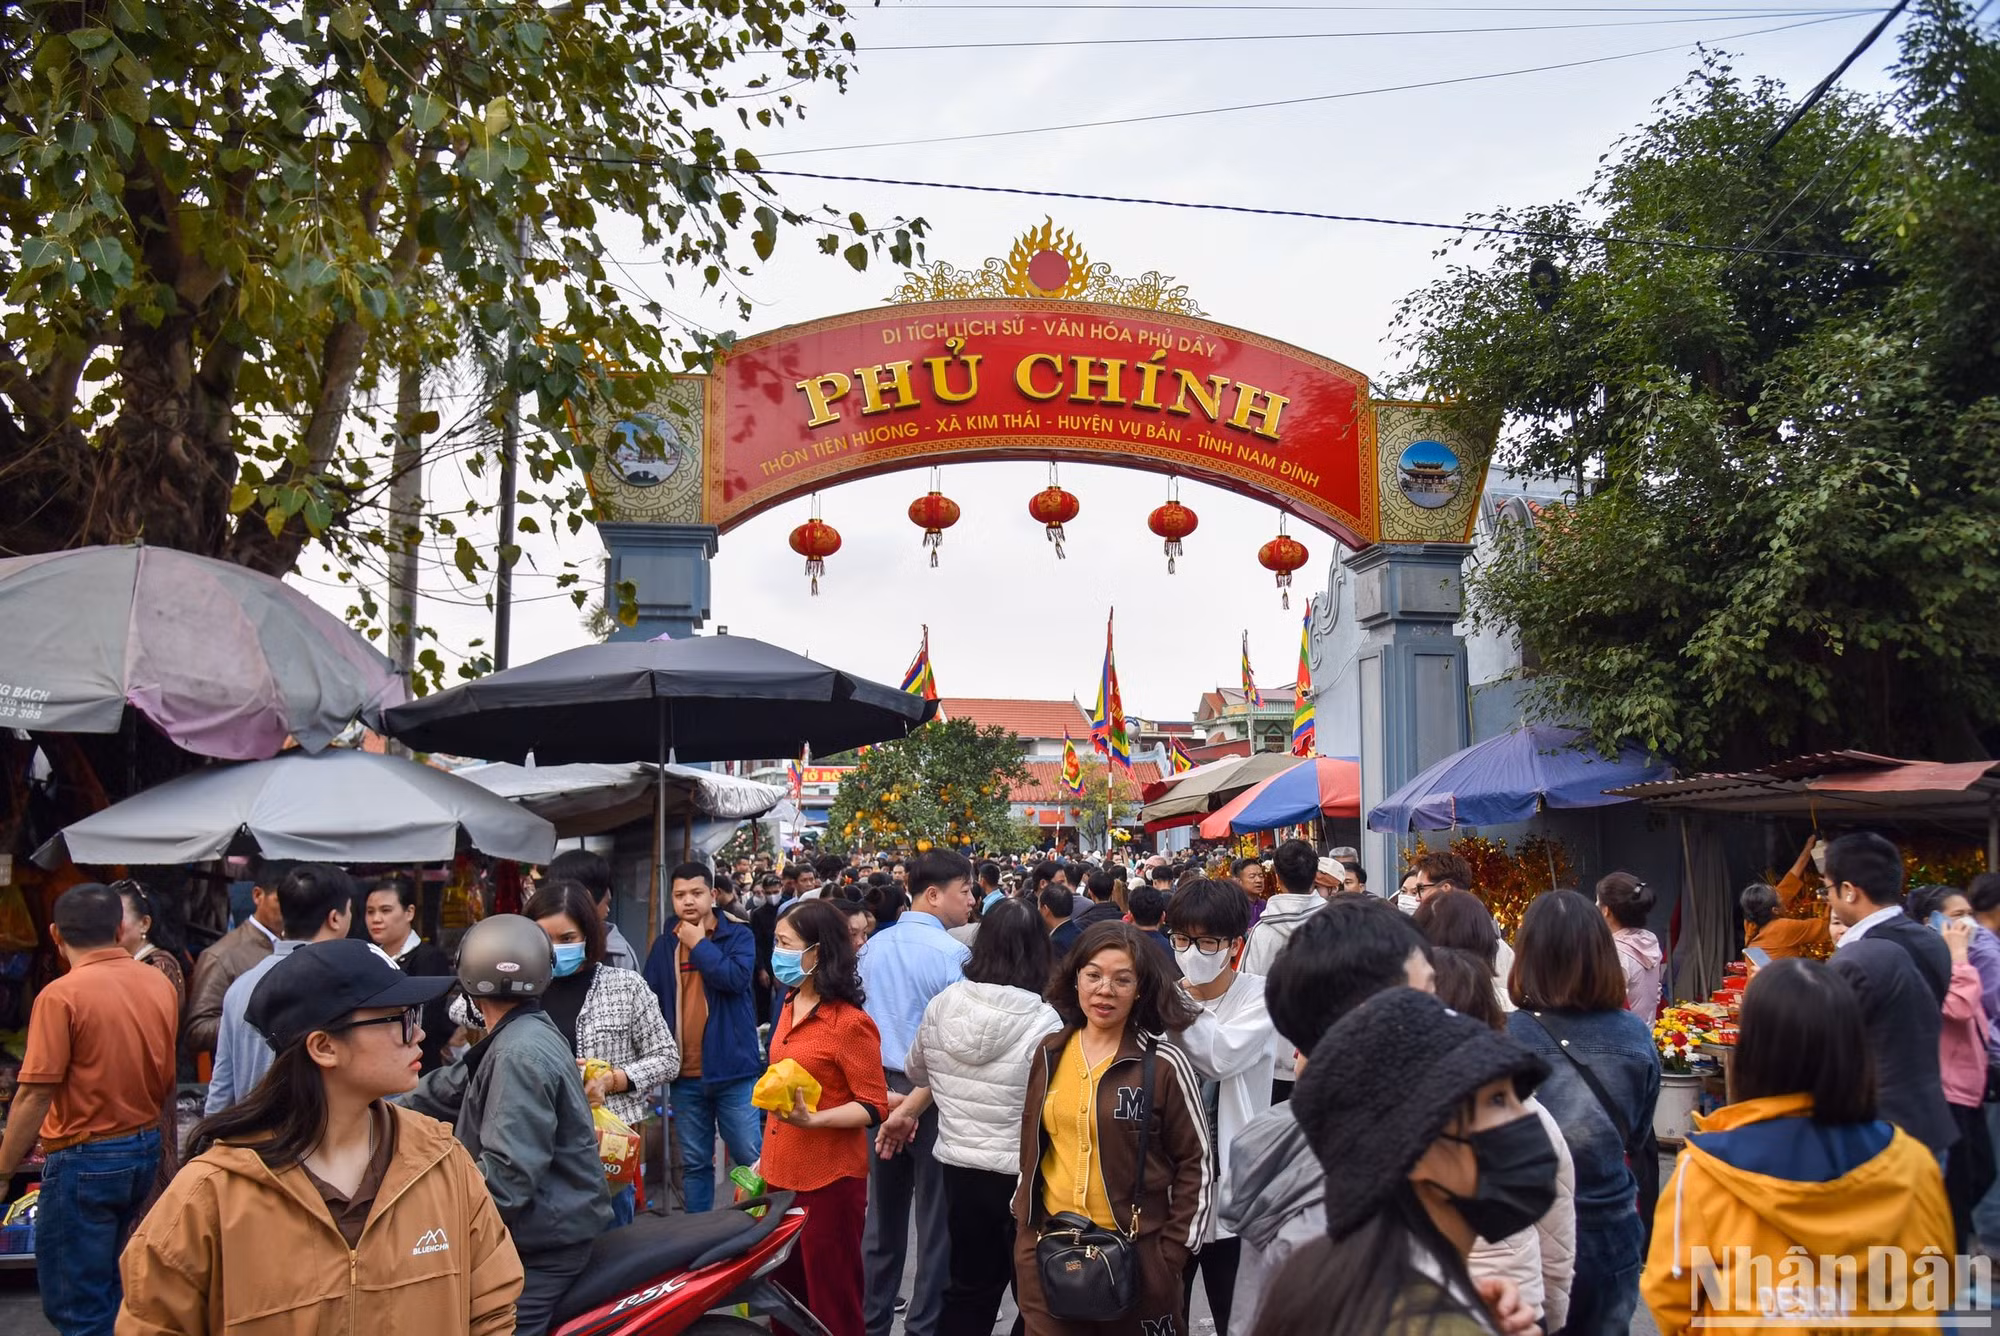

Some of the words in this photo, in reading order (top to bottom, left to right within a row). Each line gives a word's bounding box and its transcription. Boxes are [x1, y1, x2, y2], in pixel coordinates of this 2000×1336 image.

[881, 328, 901, 344] DI
[906, 320, 949, 341] TÍCH
[955, 318, 996, 340] LỊCH
[1002, 313, 1024, 335] SỬ
[1043, 318, 1084, 338] VĂN
[1091, 321, 1133, 343] HÓA
[1138, 328, 1173, 349] PHỦ
[796, 337, 983, 430] PHỦ
[1014, 348, 1291, 443] CHÍNH
[760, 447, 809, 476] THÔN
[811, 436, 849, 458] TIÊN
[852, 422, 920, 447] HƯƠNG
[936, 414, 962, 433] XÃ
[966, 414, 998, 430] KIM
[1003, 409, 1040, 429] THÁI
[1058, 414, 1113, 435] HUYỆN
[1119, 420, 1141, 437] VỤ
[1146, 421, 1181, 443] BẢN
[1198, 431, 1233, 456] TỈNH
[1237, 445, 1277, 470] NAM
[1280, 460, 1320, 489] ĐỊNH
[0, 683, 11, 696] G
[1114, 1086, 1145, 1121] M
[601, 1162, 621, 1175] Cos
